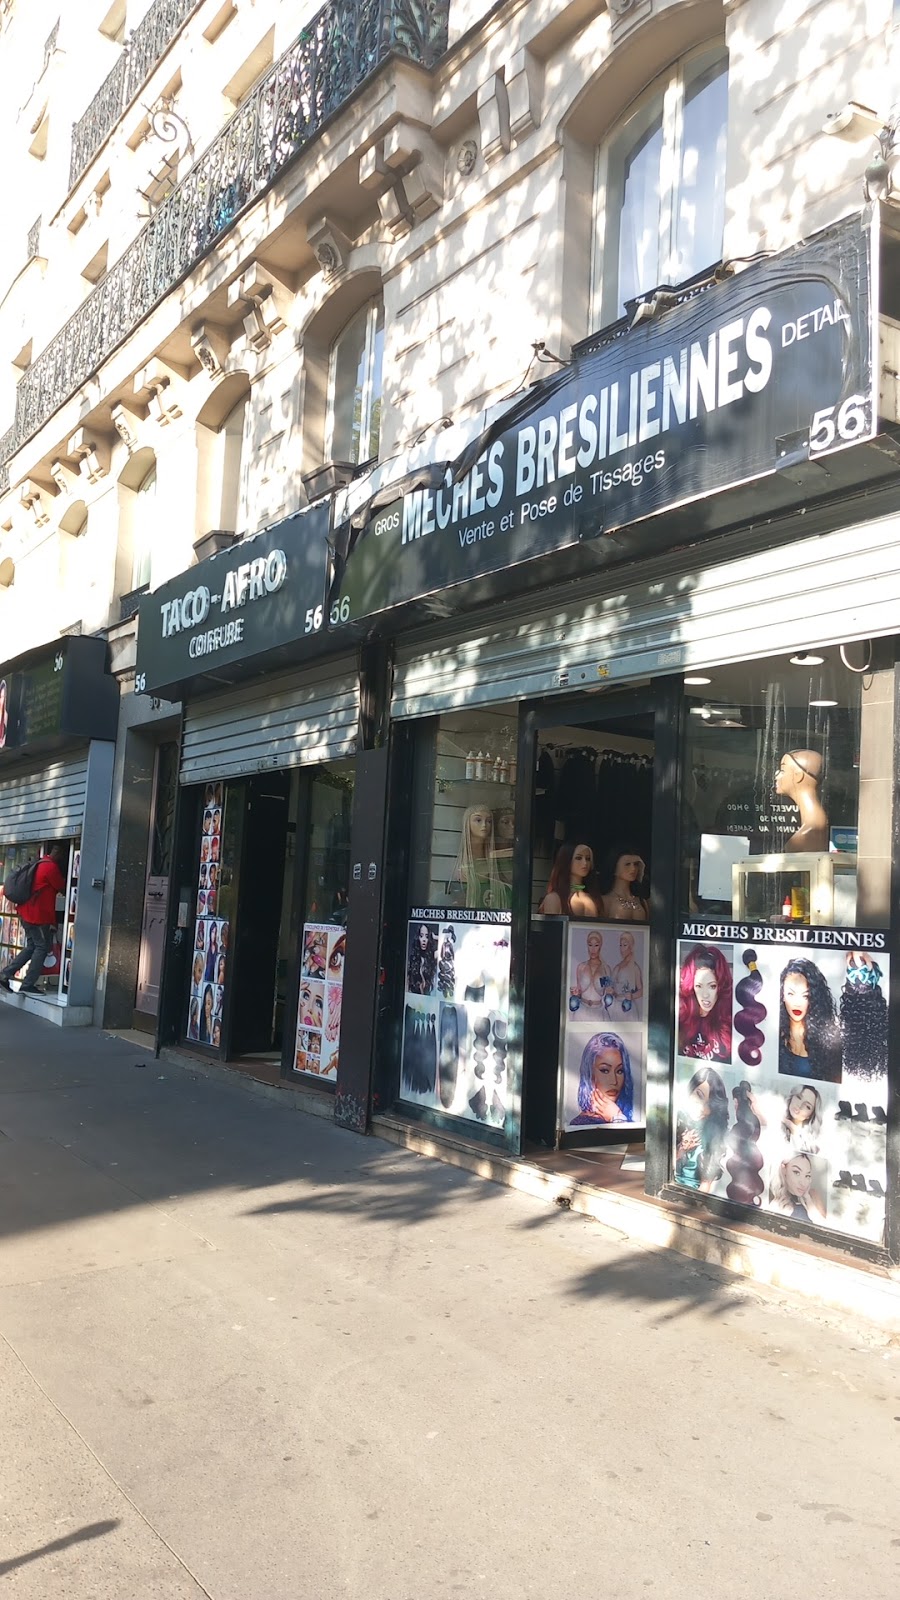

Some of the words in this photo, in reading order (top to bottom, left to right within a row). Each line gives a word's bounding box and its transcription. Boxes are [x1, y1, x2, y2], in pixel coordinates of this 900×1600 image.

[375, 512, 400, 536] GROS
[401, 440, 504, 545] MECHES
[515, 306, 772, 497] BRESILIENNES
[781, 298, 850, 348] DETAIL
[810, 394, 867, 451] 56
[458, 518, 494, 547] Vente
[500, 509, 514, 532] et
[520, 496, 557, 525] Pose
[564, 483, 582, 507] de
[590, 450, 665, 496] Tissages
[304, 604, 323, 633] 56
[330, 595, 350, 626] 56
[189, 618, 244, 658] COIFFURE
[54, 651, 63, 672] 56
[134, 672, 146, 693] 56
[411, 908, 445, 920] MECHES
[446, 909, 512, 923] BRESILIENNES
[682, 923, 748, 939] MECHES
[752, 927, 885, 948] BRESILIENNES
